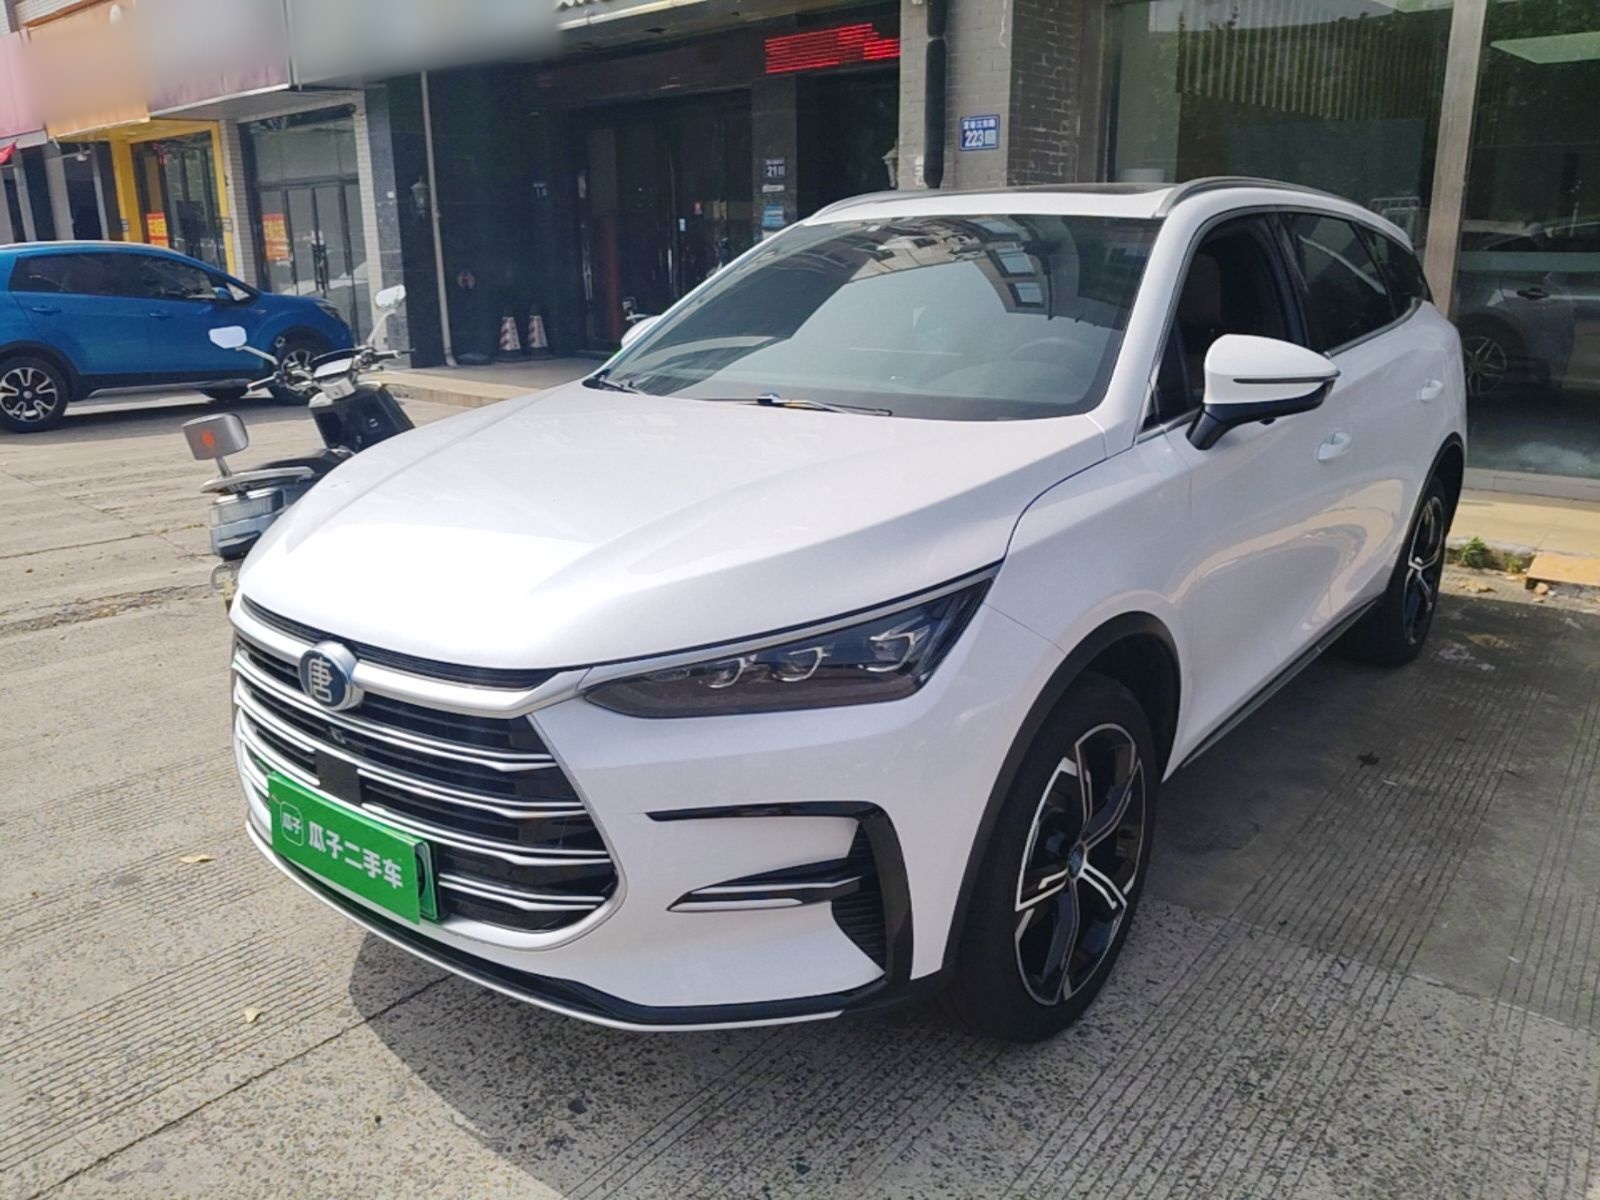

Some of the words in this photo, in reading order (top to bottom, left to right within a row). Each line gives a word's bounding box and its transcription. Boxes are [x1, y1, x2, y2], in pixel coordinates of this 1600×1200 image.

[964, 129, 983, 147] 223
[309, 821, 403, 889] 瓜子二手车
